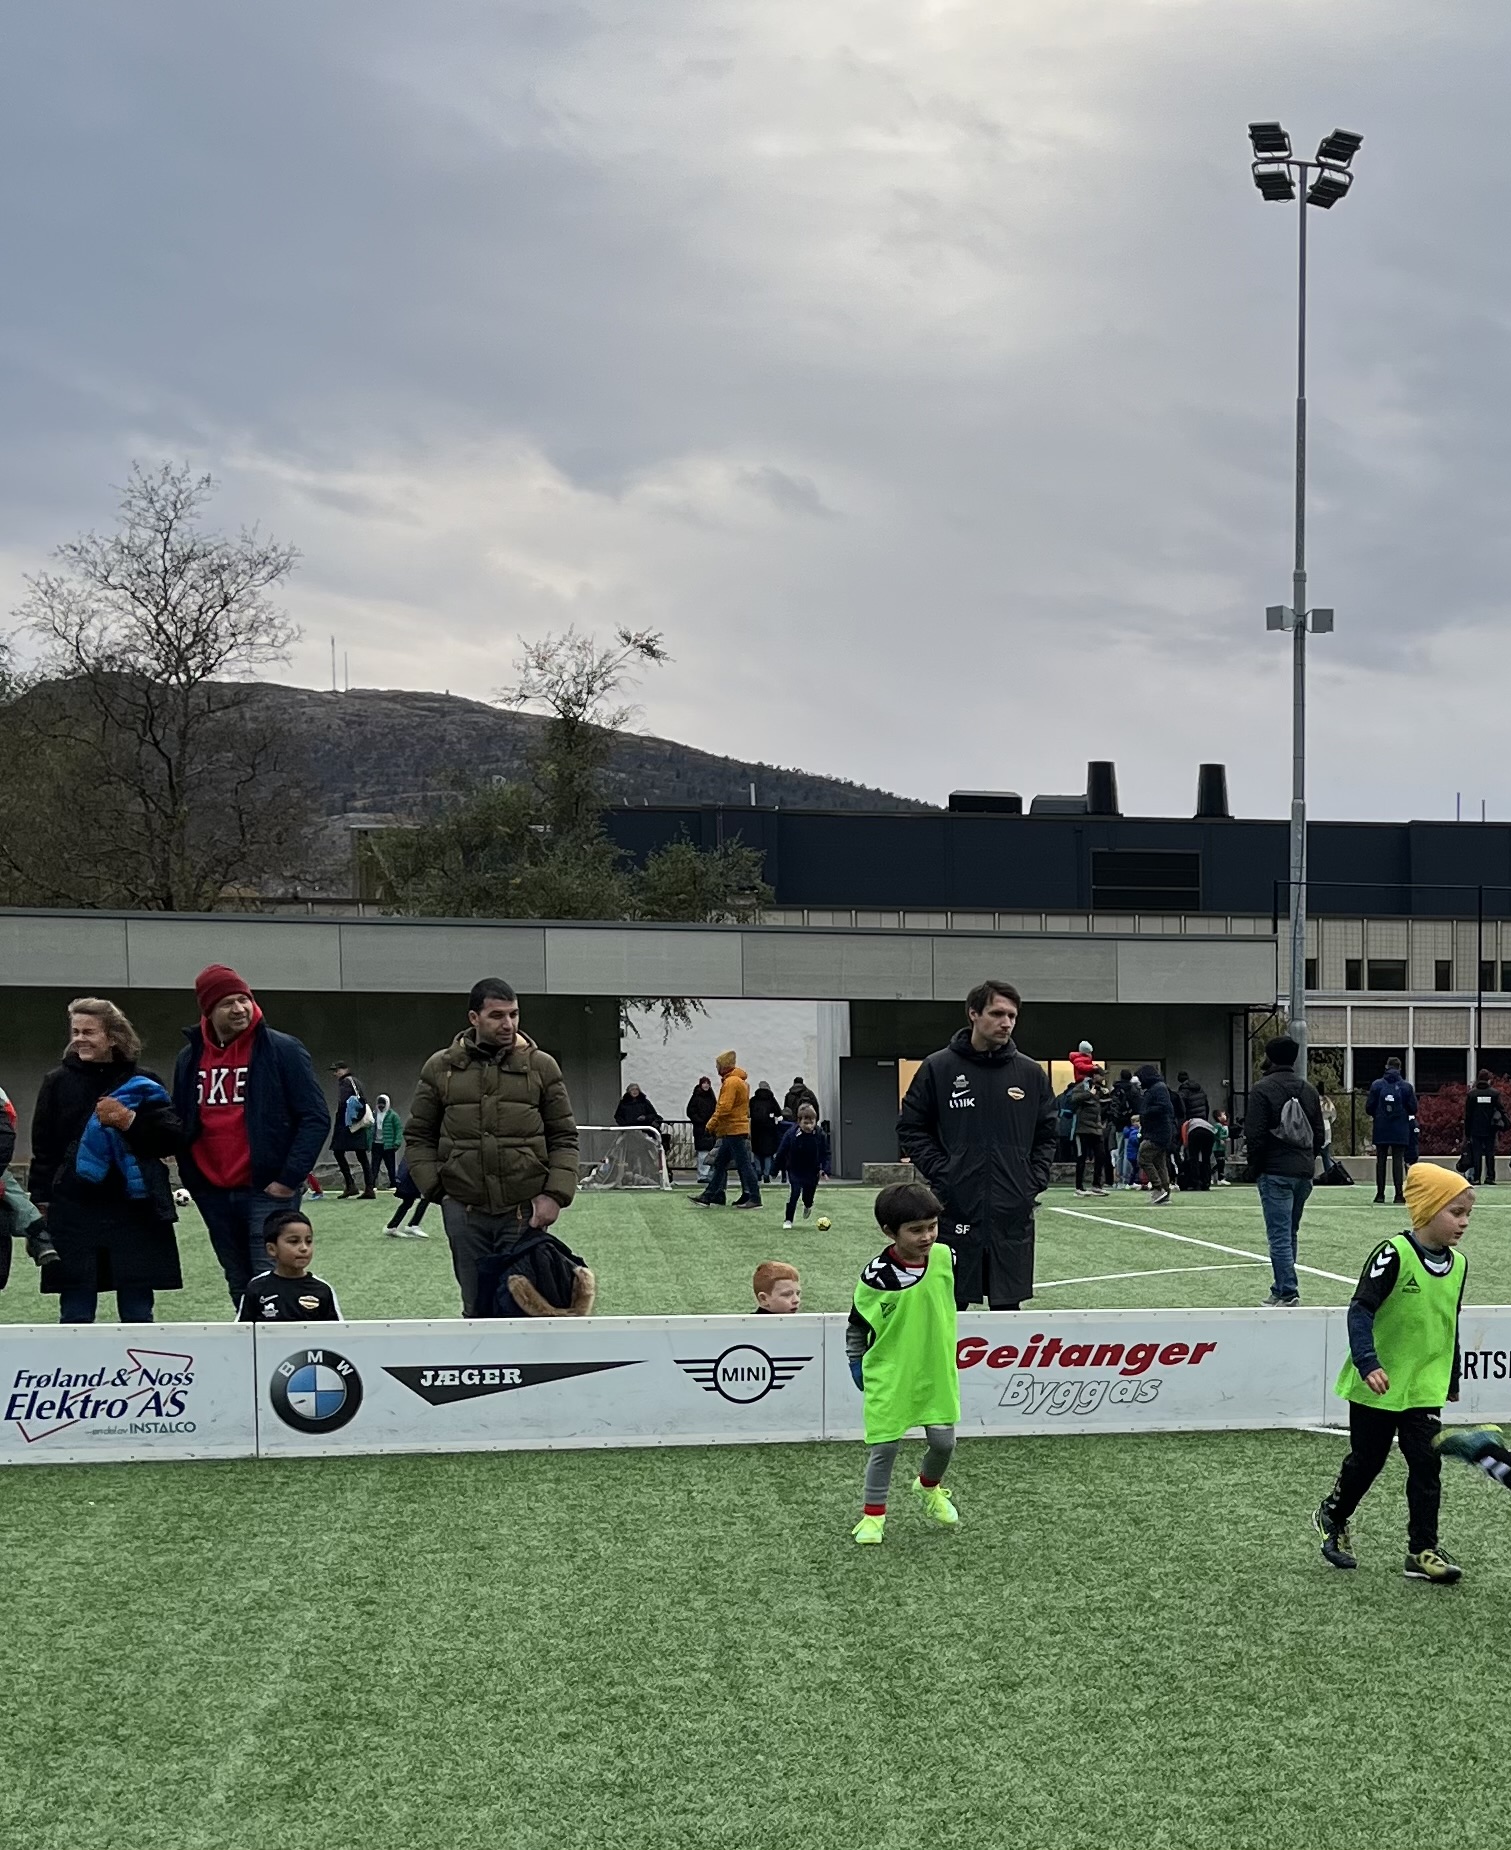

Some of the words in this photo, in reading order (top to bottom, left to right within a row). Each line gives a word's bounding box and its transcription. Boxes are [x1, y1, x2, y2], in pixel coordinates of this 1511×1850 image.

[955, 1224, 970, 1234] SF
[278, 1350, 353, 1377] BMW
[957, 1334, 1217, 1375] Geitanger
[13, 1367, 105, 1388] Frøland
[110, 1368, 131, 1387] &
[138, 1368, 195, 1387] Noss
[420, 1368, 522, 1387] JÆGER
[722, 1367, 766, 1382] MINI
[998, 1373, 1110, 1415] Bygg
[1109, 1378, 1162, 1403] as
[4, 1390, 128, 1420] Elektro
[136, 1390, 188, 1418] AS
[130, 1421, 196, 1434] INSTALCO
